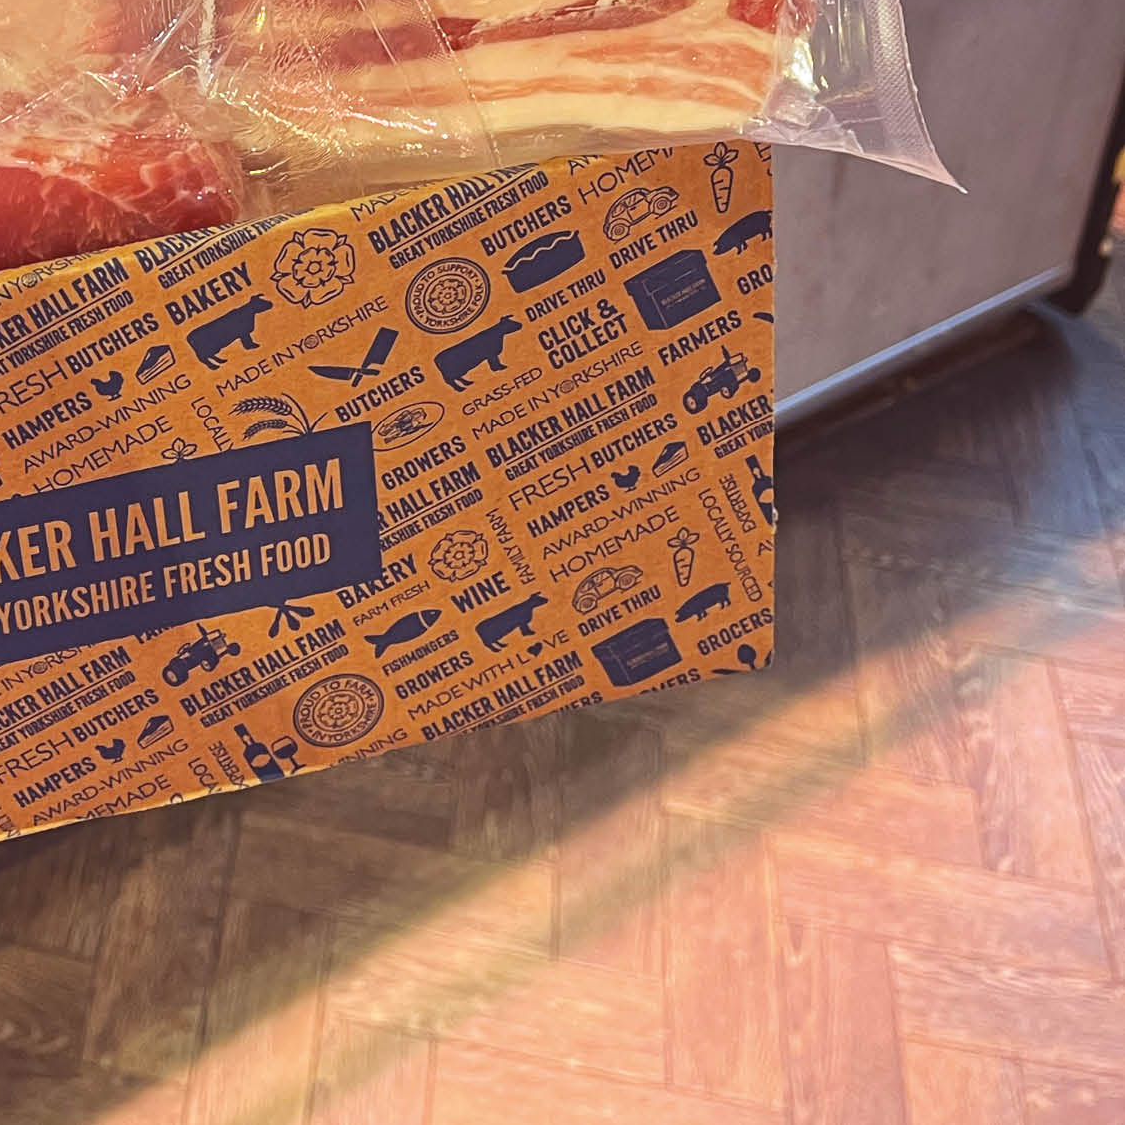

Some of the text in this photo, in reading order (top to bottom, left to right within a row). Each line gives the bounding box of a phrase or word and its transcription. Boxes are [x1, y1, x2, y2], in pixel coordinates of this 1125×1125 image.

[480, 195, 572, 256] BUTCHERS
[609, 211, 699, 269] DRIVE THRU
[26, 289, 77, 328] HALL
[75, 257, 130, 297] FARM
[164, 261, 253, 326] BAKERY
[6, 327, 70, 368] YORKSHIRE
[69, 308, 104, 338] FRESH
[103, 290, 134, 316] FOOD
[64, 312, 160, 375] BUTCHERS
[538, 298, 618, 352] CLICK &
[547, 313, 629, 369] COLLECT
[658, 309, 742, 367] FARMERS
[1, 391, 92, 450] HAMPERS
[24, 374, 192, 473] AWARD-WINNING
[381, 435, 467, 491] GROWERS
[87, 490, 206, 564] HALL
[216, 457, 344, 543] FARM
[527, 484, 609, 537] HAMPERS
[543, 468, 701, 560] AWARD-WINNING
[162, 549, 252, 601] FRESH
[259, 533, 332, 580] FOOD
[550, 506, 680, 582] HOMEMADE
[699, 488, 762, 602] LOCALLY SOURCED
[451, 570, 511, 614] WINE
[381, 630, 460, 677] FISHMONGERS
[697, 608, 773, 656] GROCERS
